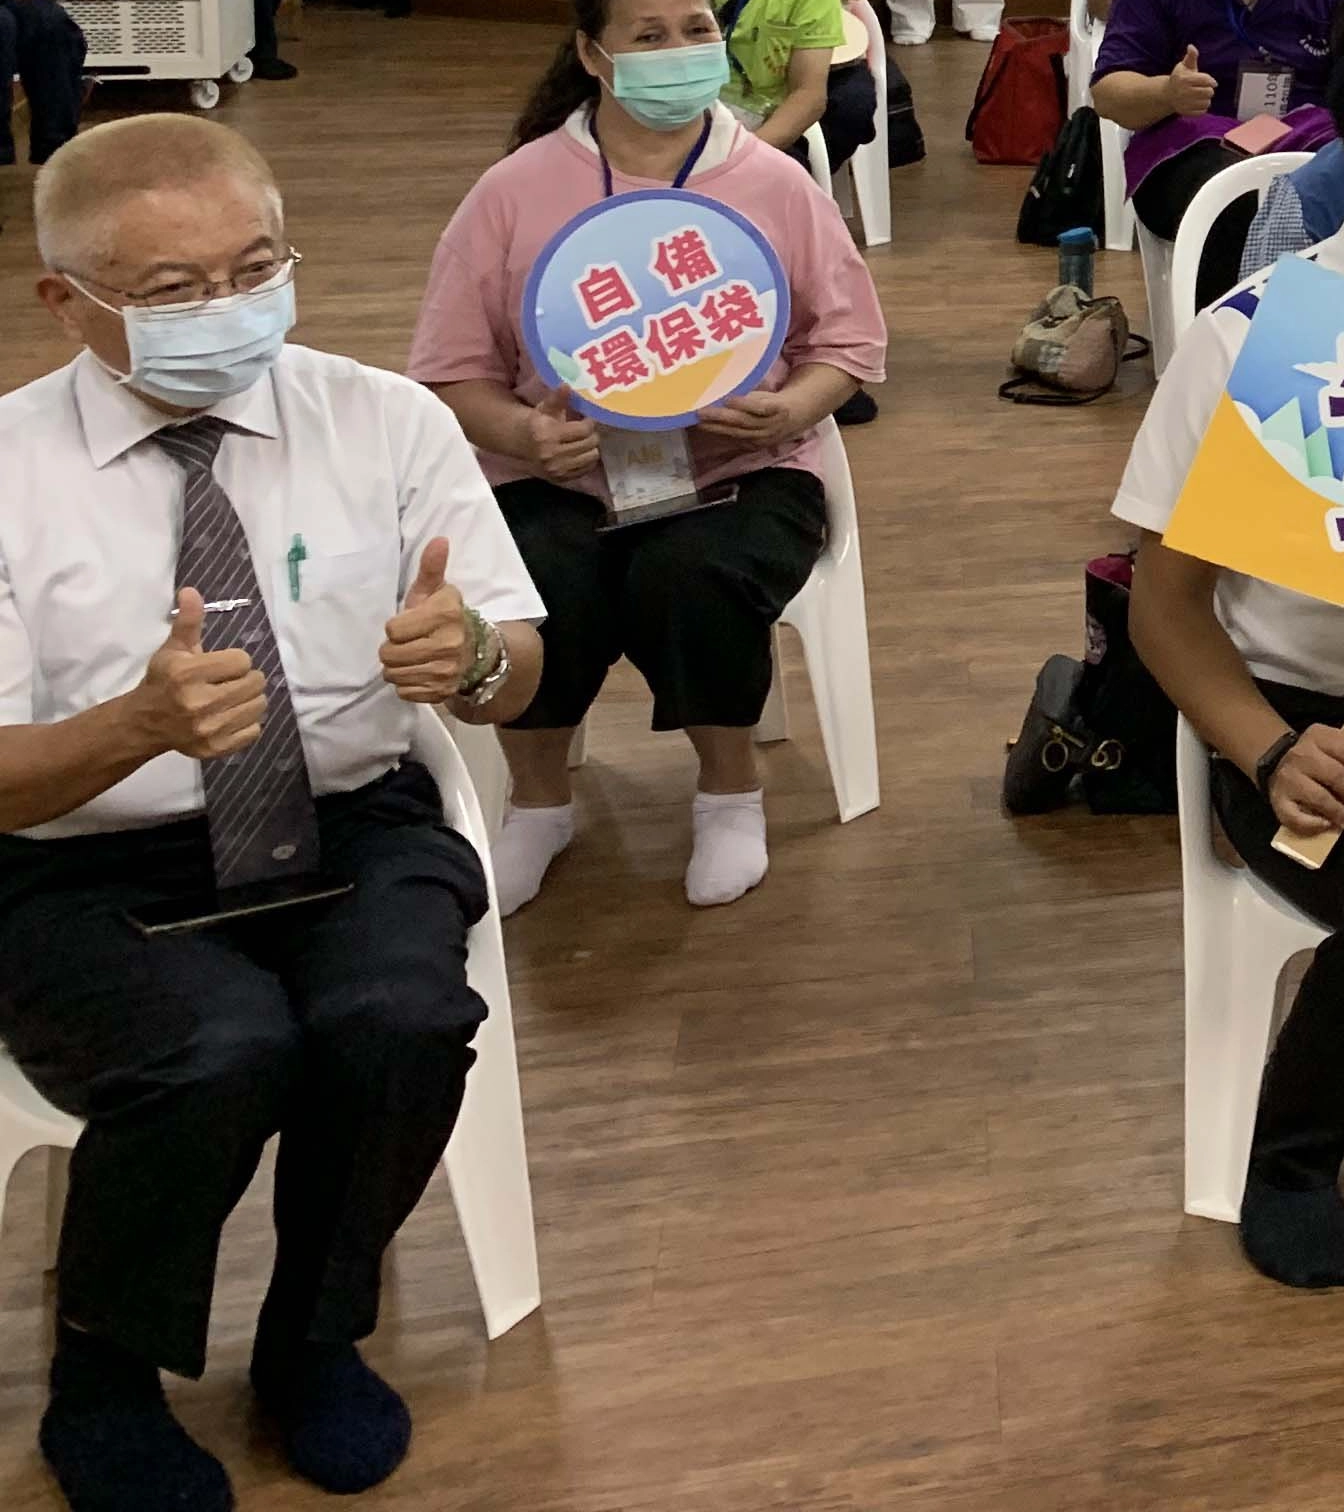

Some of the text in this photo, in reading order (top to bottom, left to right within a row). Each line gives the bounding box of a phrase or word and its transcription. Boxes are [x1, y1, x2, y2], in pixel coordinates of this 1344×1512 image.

[577, 229, 717, 324] 自備
[580, 284, 764, 394] 環保袋
